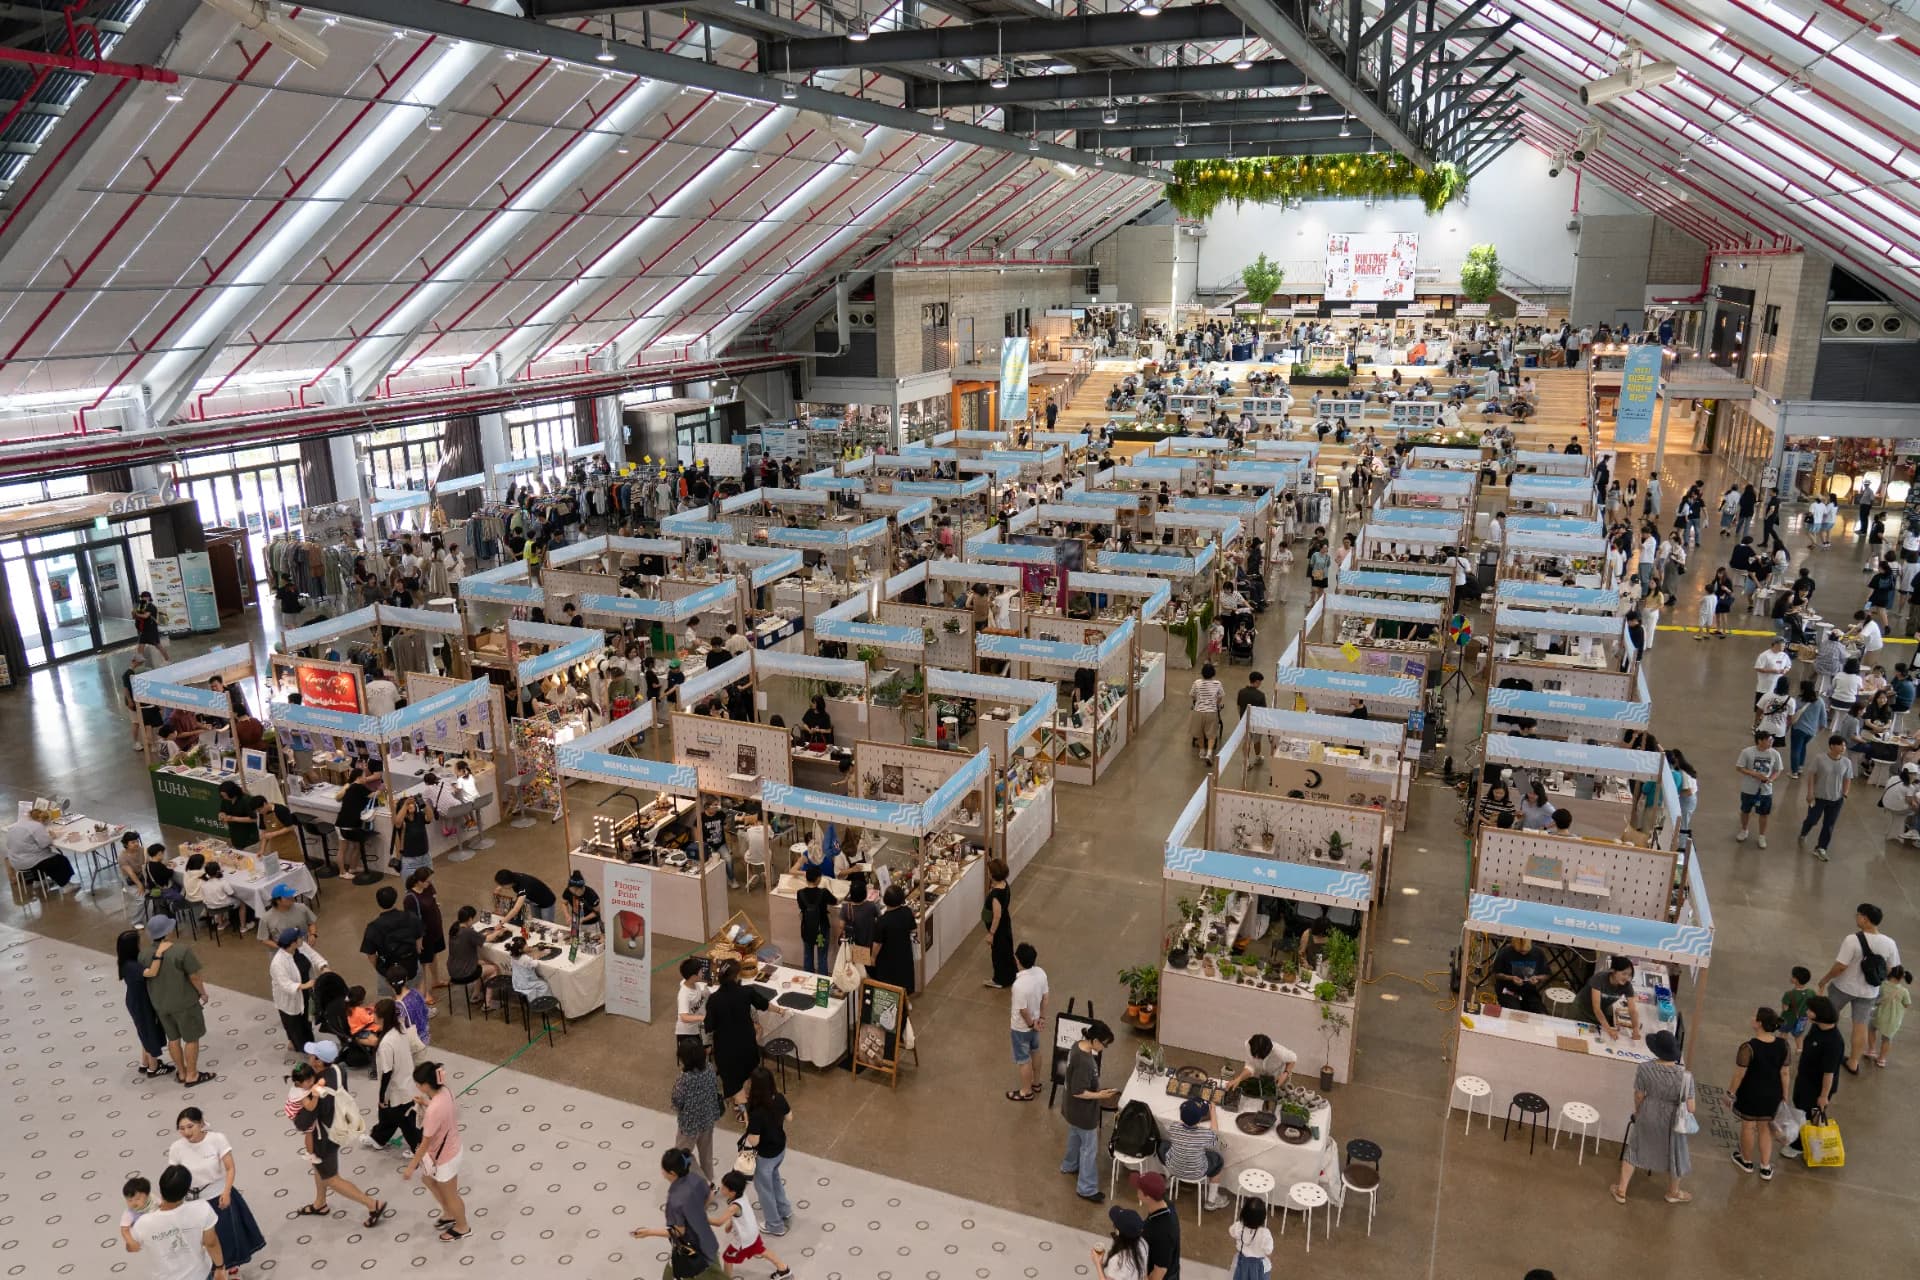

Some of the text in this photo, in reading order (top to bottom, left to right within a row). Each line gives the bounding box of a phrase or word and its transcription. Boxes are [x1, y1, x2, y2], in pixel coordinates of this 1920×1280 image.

[1354, 253, 1389, 265] VINTAGE
[1354, 263, 1387, 275] MARKET
[112, 476, 177, 513] GATE 6
[157, 779, 190, 798] LUHA
[614, 880, 641, 891] Finger
[617, 889, 638, 899] Print
